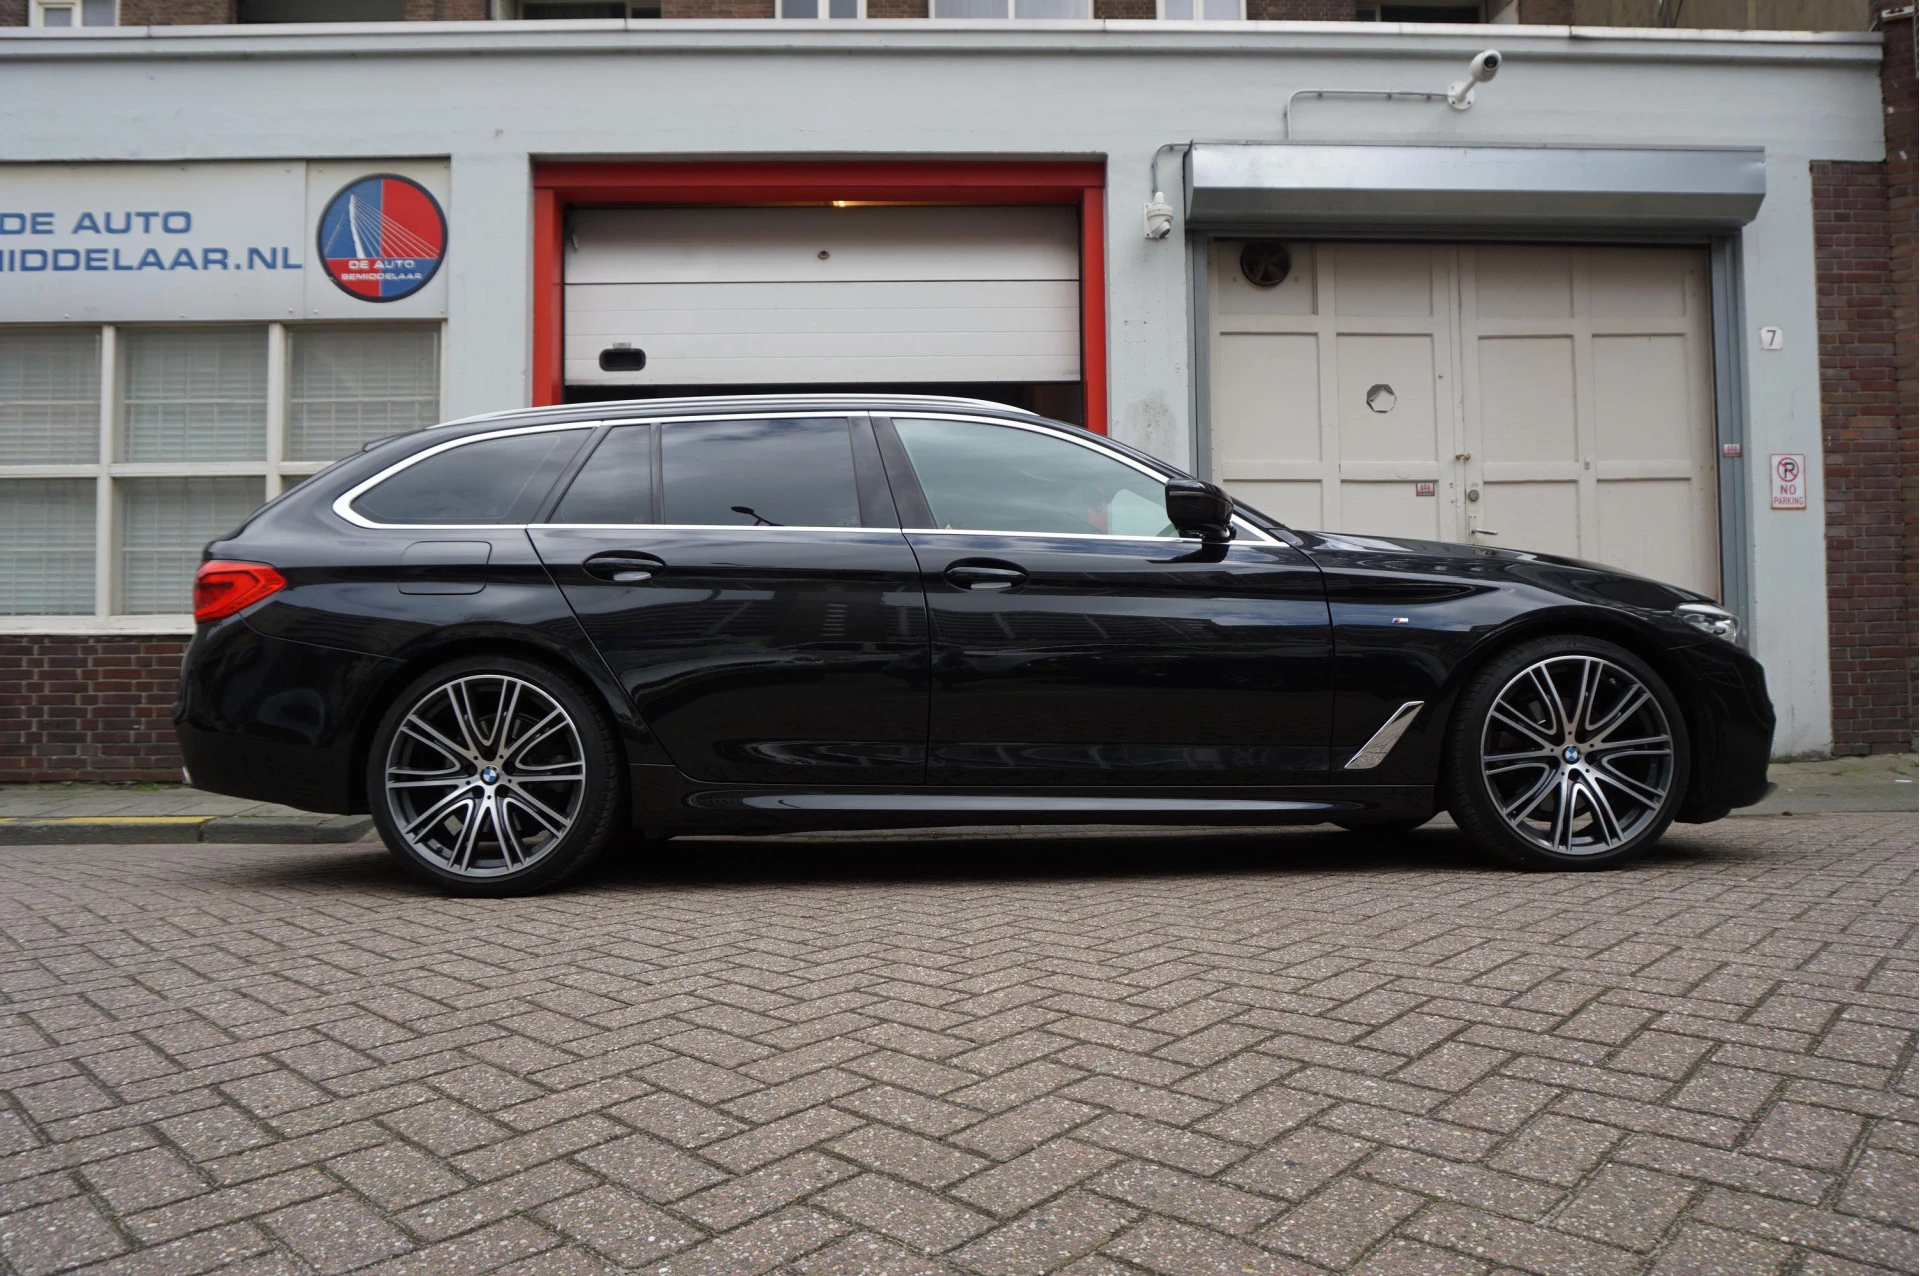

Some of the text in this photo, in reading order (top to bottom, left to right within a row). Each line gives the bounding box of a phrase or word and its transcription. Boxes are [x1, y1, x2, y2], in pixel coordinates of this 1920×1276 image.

[0, 211, 192, 235] DE AUTO
[0, 247, 303, 272] IDDELAAR.NL
[348, 260, 415, 269] DE AUTO
[341, 272, 422, 281] BEMIDDELAAR
[1766, 329, 1776, 346] 7
[1780, 484, 1797, 495] NO
[1773, 496, 1804, 506] PARKING
